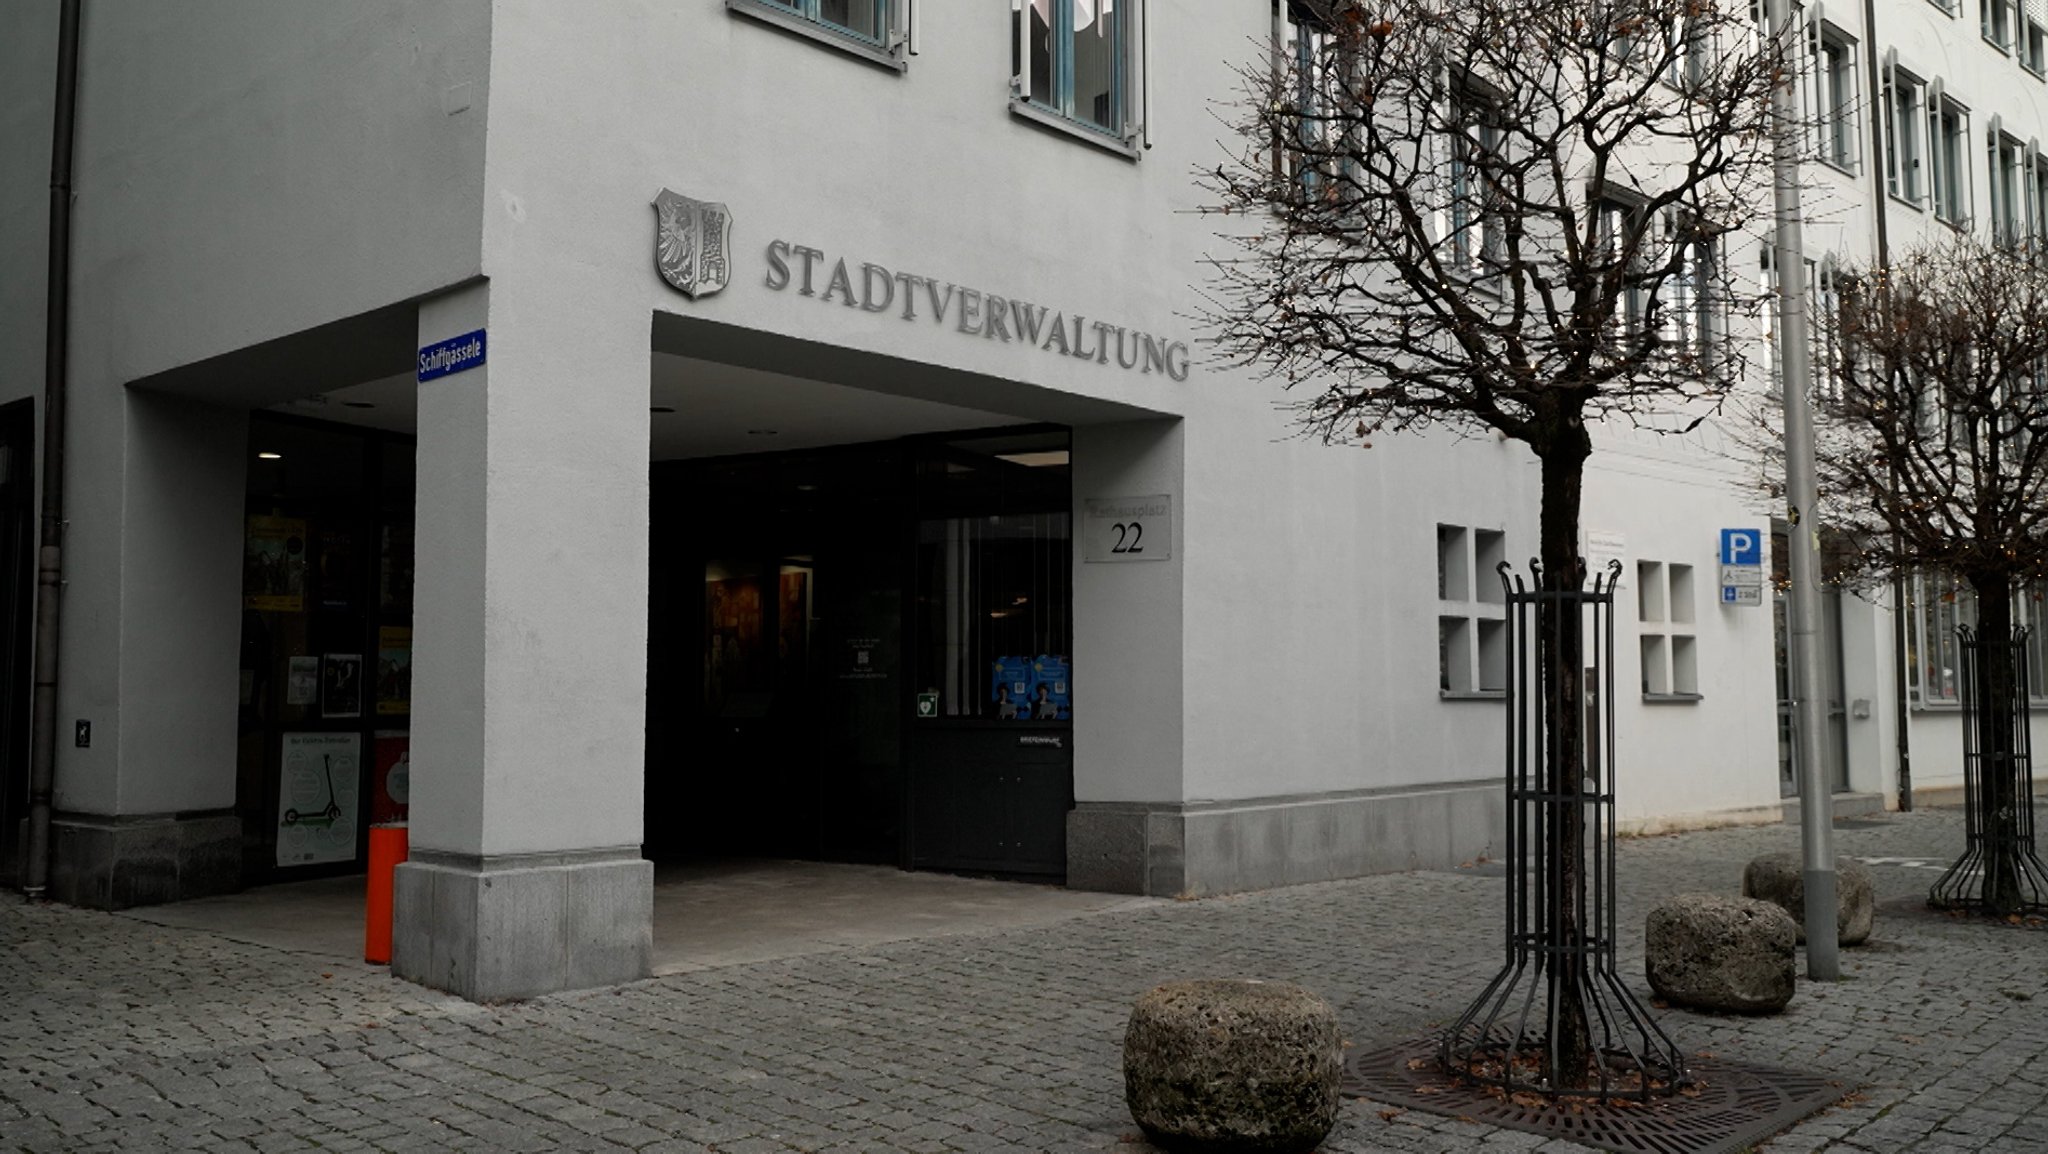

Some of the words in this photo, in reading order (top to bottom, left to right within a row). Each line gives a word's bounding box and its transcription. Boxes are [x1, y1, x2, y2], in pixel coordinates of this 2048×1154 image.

[764, 237, 1190, 382] STADTVERWALTUNG
[1111, 522, 1144, 553] 22
[1730, 533, 1752, 564] P
